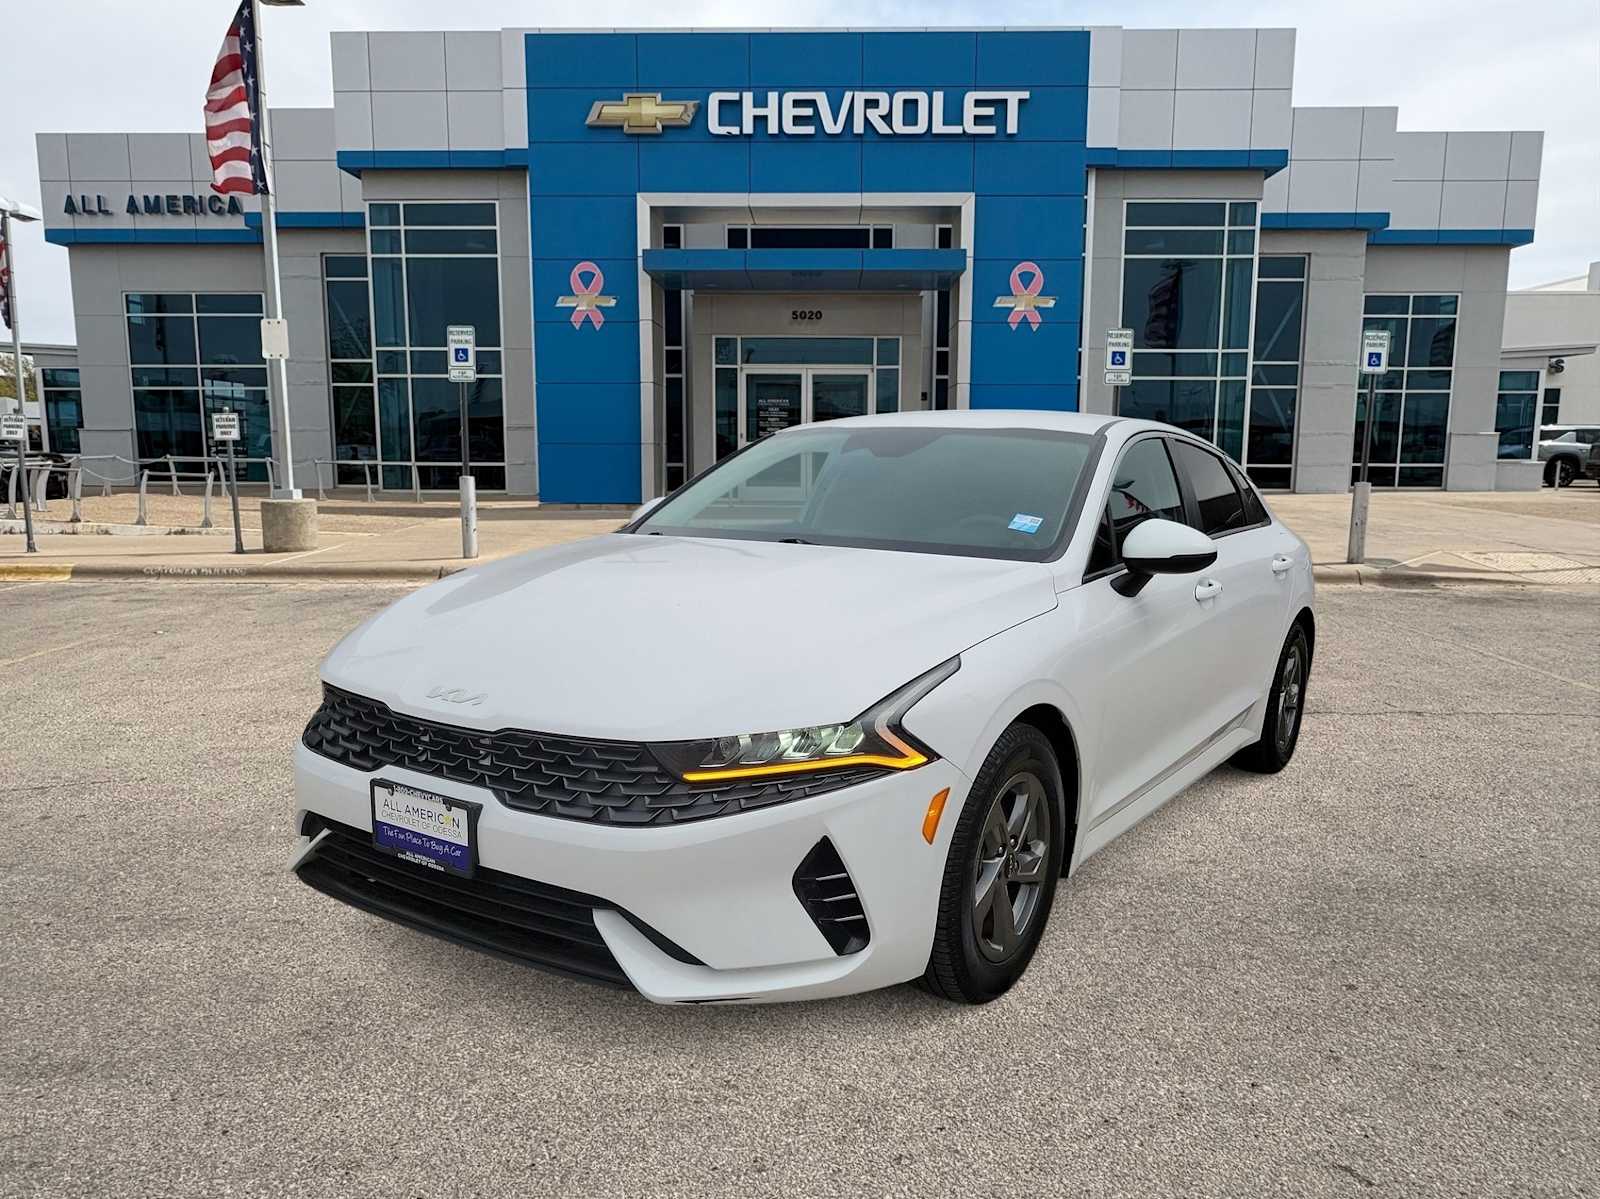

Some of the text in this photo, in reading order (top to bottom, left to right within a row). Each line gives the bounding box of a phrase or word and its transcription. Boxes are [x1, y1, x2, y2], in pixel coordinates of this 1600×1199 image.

[707, 90, 1031, 136] CHEVROLET
[64, 194, 112, 215] ALL
[791, 310, 823, 320] 5020
[384, 798, 402, 812] ALL
[381, 810, 463, 839] CHEVROLET OF ODESSA
[383, 825, 462, 857] The Fun Place To Buy A Car
